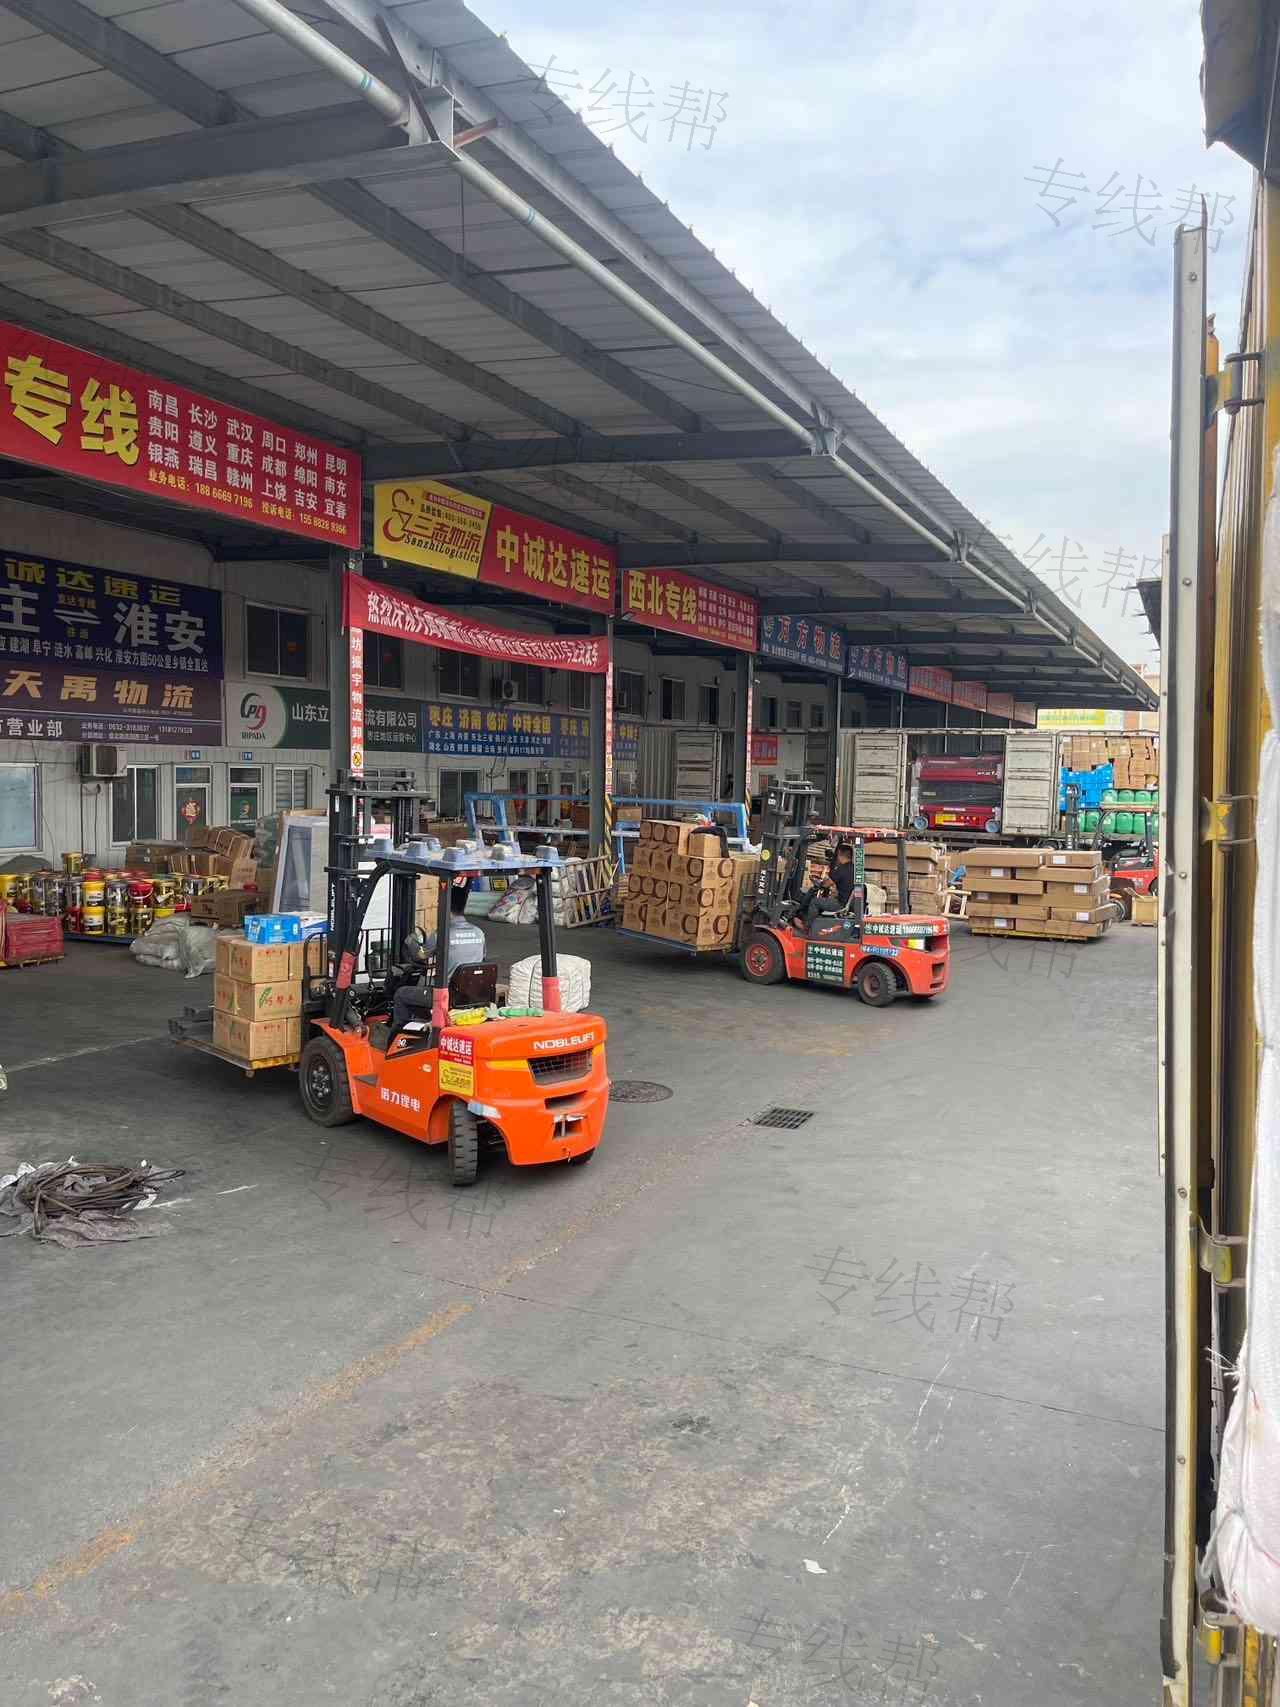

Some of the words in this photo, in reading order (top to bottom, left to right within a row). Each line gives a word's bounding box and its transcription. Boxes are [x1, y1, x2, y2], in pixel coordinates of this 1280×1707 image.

[4, 354, 140, 465] 专线
[148, 389, 179, 418] 南昌
[188, 403, 218, 430] 长沙
[226, 418, 253, 444] 武汉
[262, 430, 287, 454] 周口
[294, 442, 318, 466] 郑州
[325, 453, 347, 476] 昆明
[148, 416, 179, 443] 贵阳
[188, 430, 218, 456] 遵义
[226, 442, 253, 468] 重庆
[262, 456, 287, 477] 成都
[294, 465, 318, 488] 绵阳
[325, 476, 347, 498] 南充
[188, 456, 218, 481] 瑞昌
[226, 467, 253, 493] 赣州
[262, 480, 287, 502] 上饶
[294, 488, 318, 511] 吉安
[325, 498, 347, 520] 宜春
[496, 525, 611, 600] 中诚达速运
[114, 601, 206, 653] 淮安
[628, 570, 698, 625] 西北专线
[440, 1034, 473, 1056] 中诚达速运
